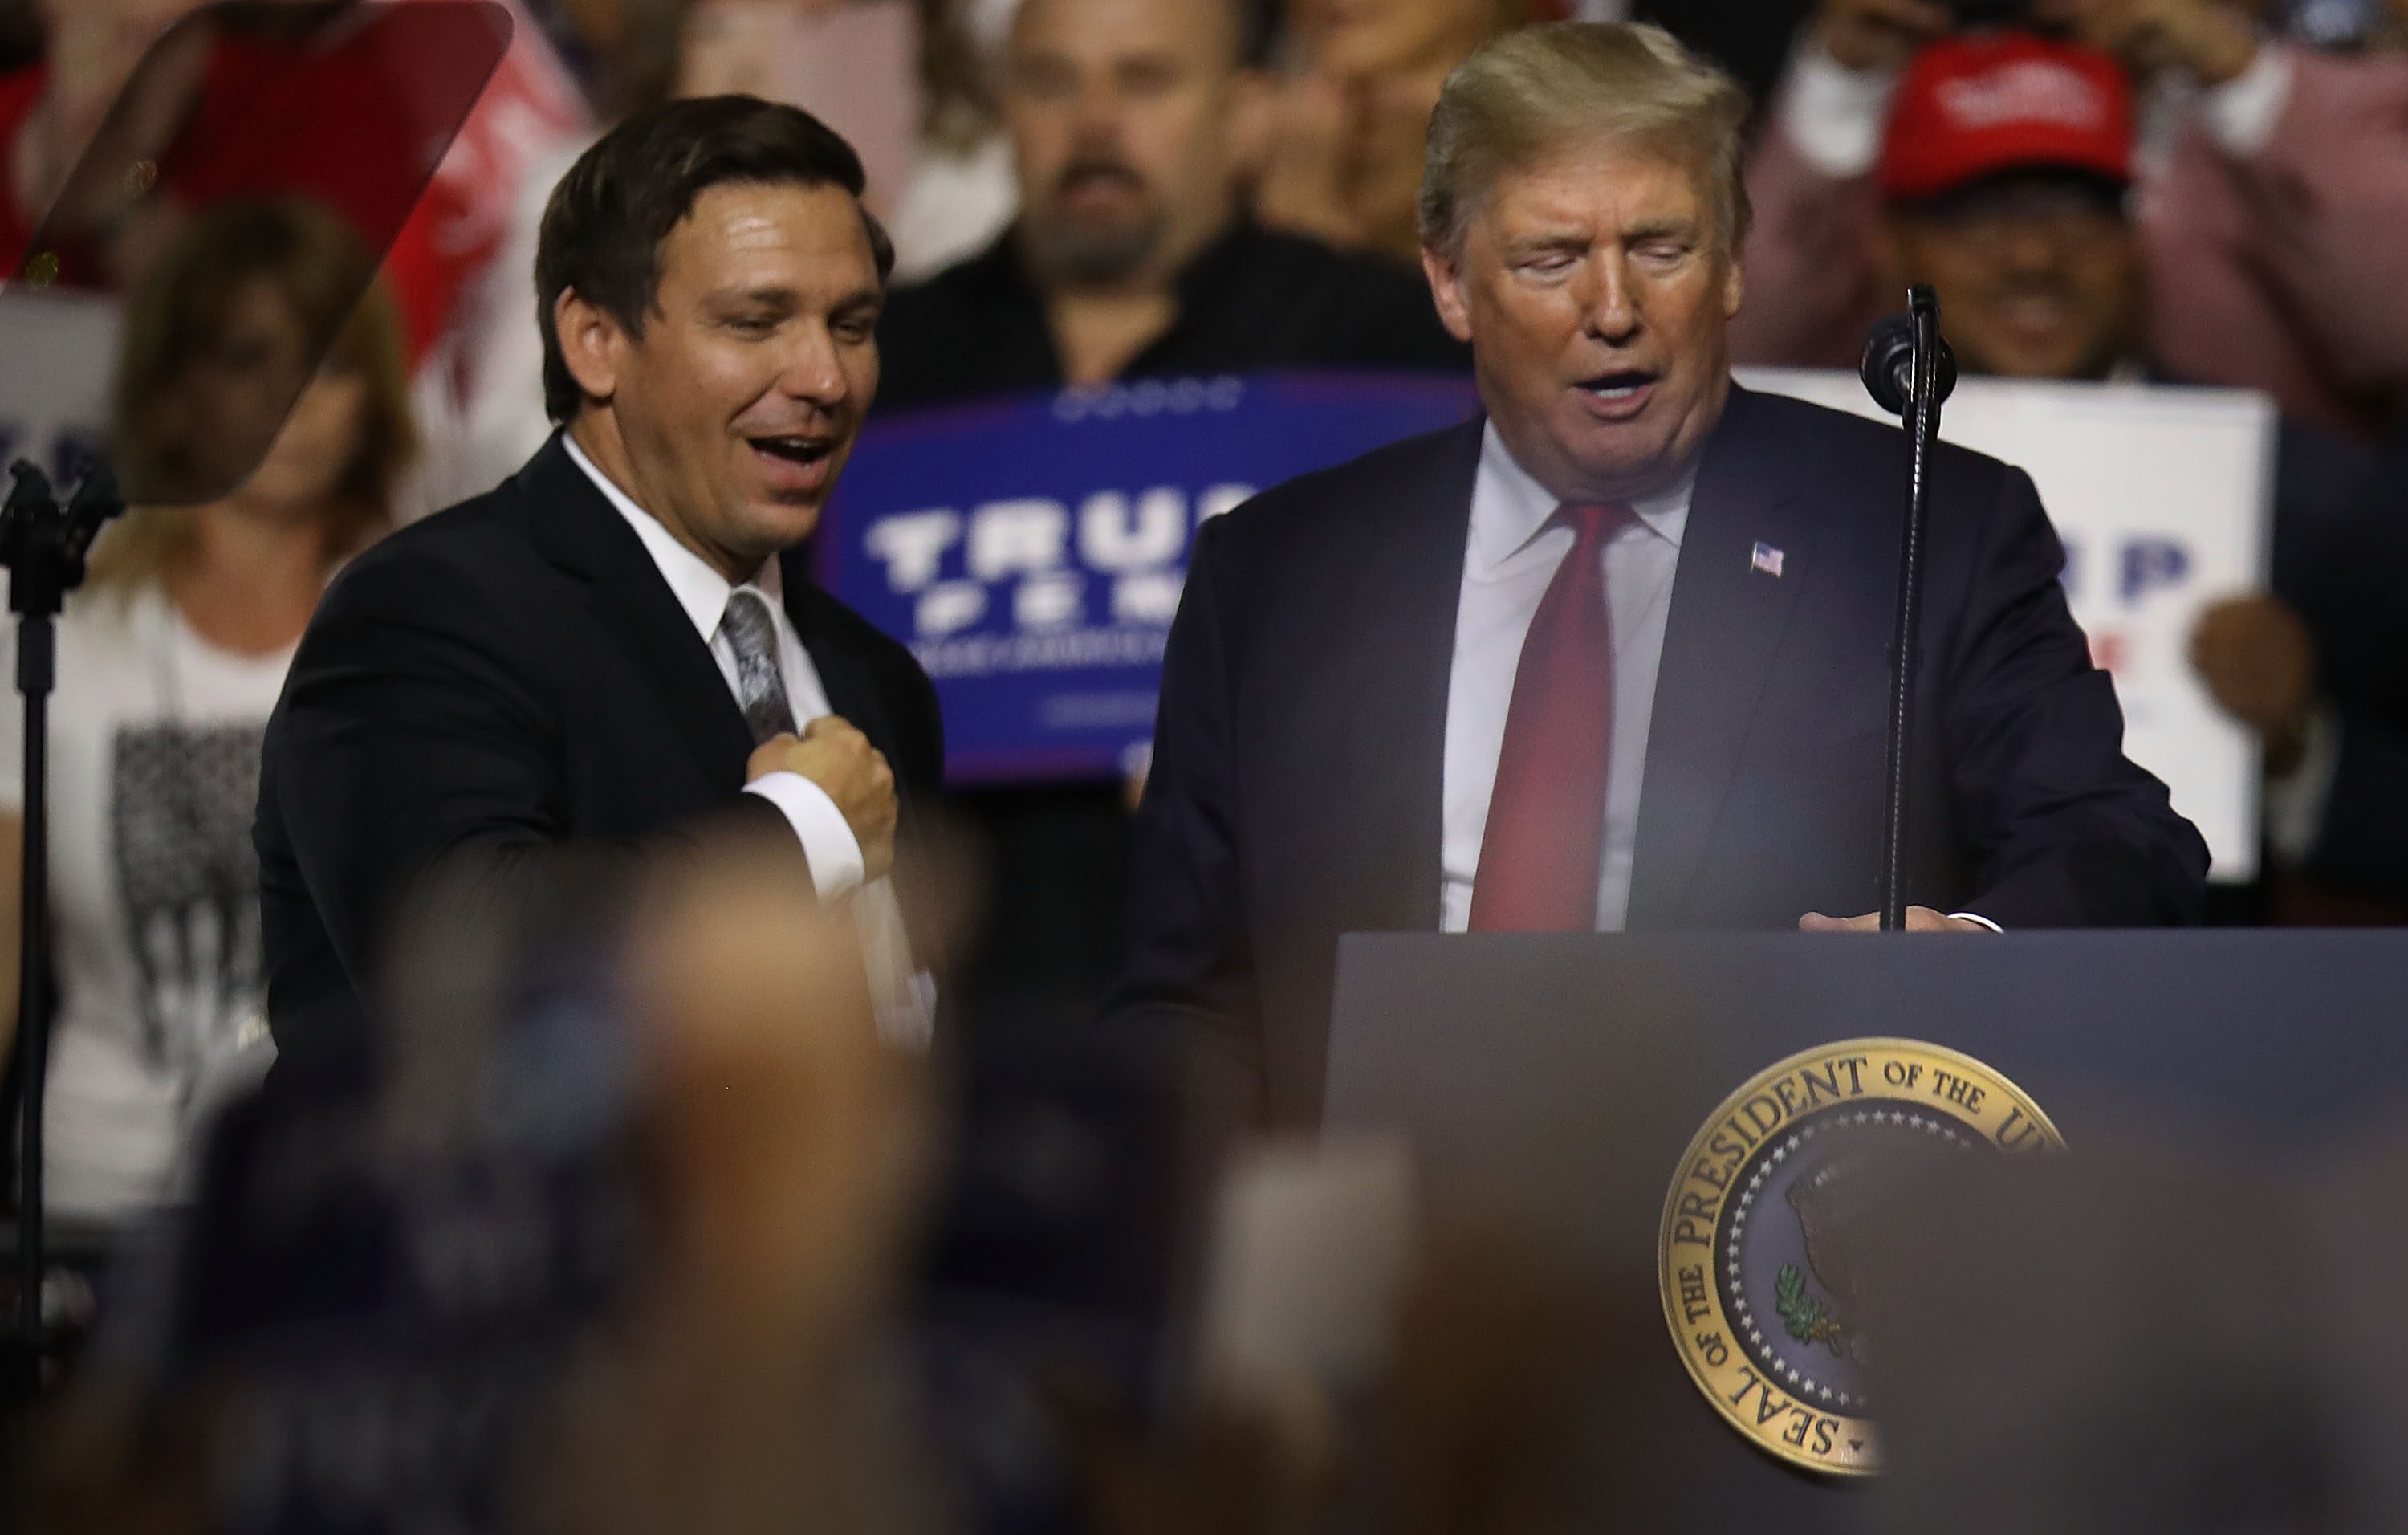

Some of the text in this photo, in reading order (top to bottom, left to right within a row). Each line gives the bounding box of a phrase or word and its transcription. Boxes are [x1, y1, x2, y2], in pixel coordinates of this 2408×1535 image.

[864, 483, 1259, 594] TRU
[1883, 1059, 1924, 1089] OF
[1932, 1069, 1987, 1115] THE
[1674, 1055, 1869, 1248] PRESIDENT
[1679, 1264, 1710, 1324] THE
[1696, 1329, 1730, 1366] OF
[1728, 1366, 1840, 1456] SEAL
